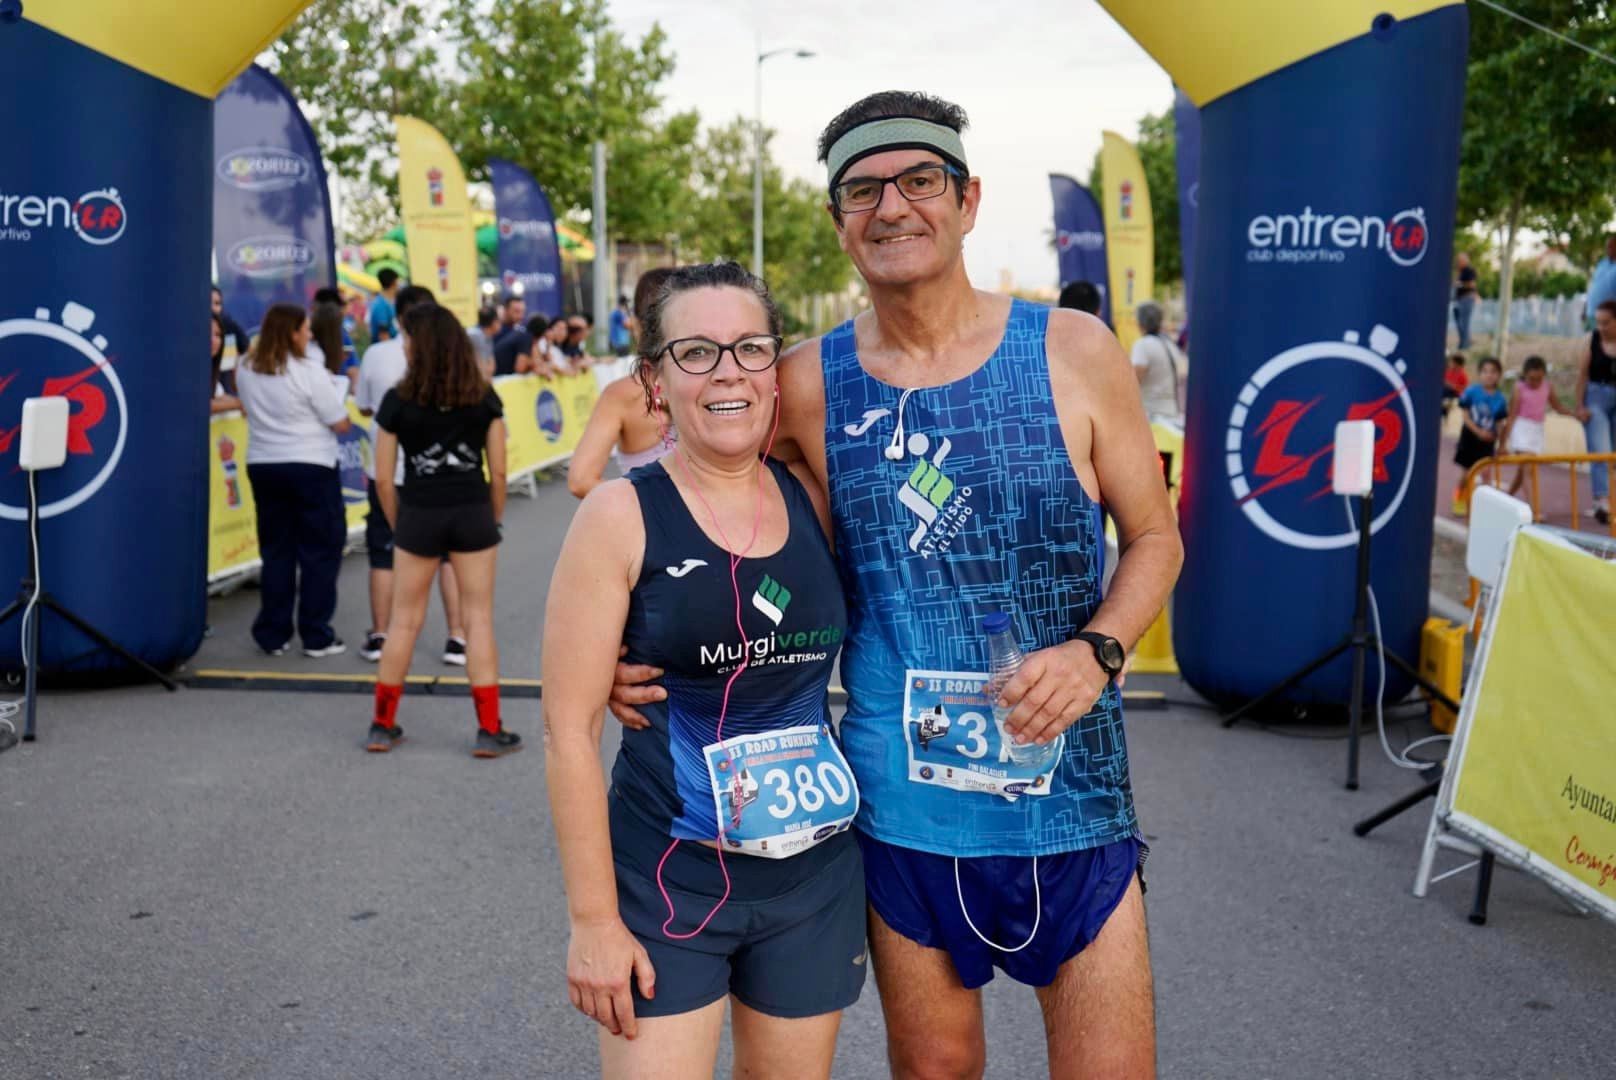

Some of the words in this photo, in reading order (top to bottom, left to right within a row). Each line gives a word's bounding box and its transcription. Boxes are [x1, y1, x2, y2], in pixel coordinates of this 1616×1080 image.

[1247, 249, 1274, 262] club
[1276, 249, 1345, 264] deportivo
[920, 486, 973, 559] ATLETISMO
[938, 539, 951, 553] EL
[947, 506, 973, 539] EJIDO
[750, 658, 770, 667] DE
[767, 652, 827, 664] ATLETISMO
[744, 738, 778, 756] ROAD
[779, 733, 819, 749] RUNNING
[763, 761, 851, 819] 380
